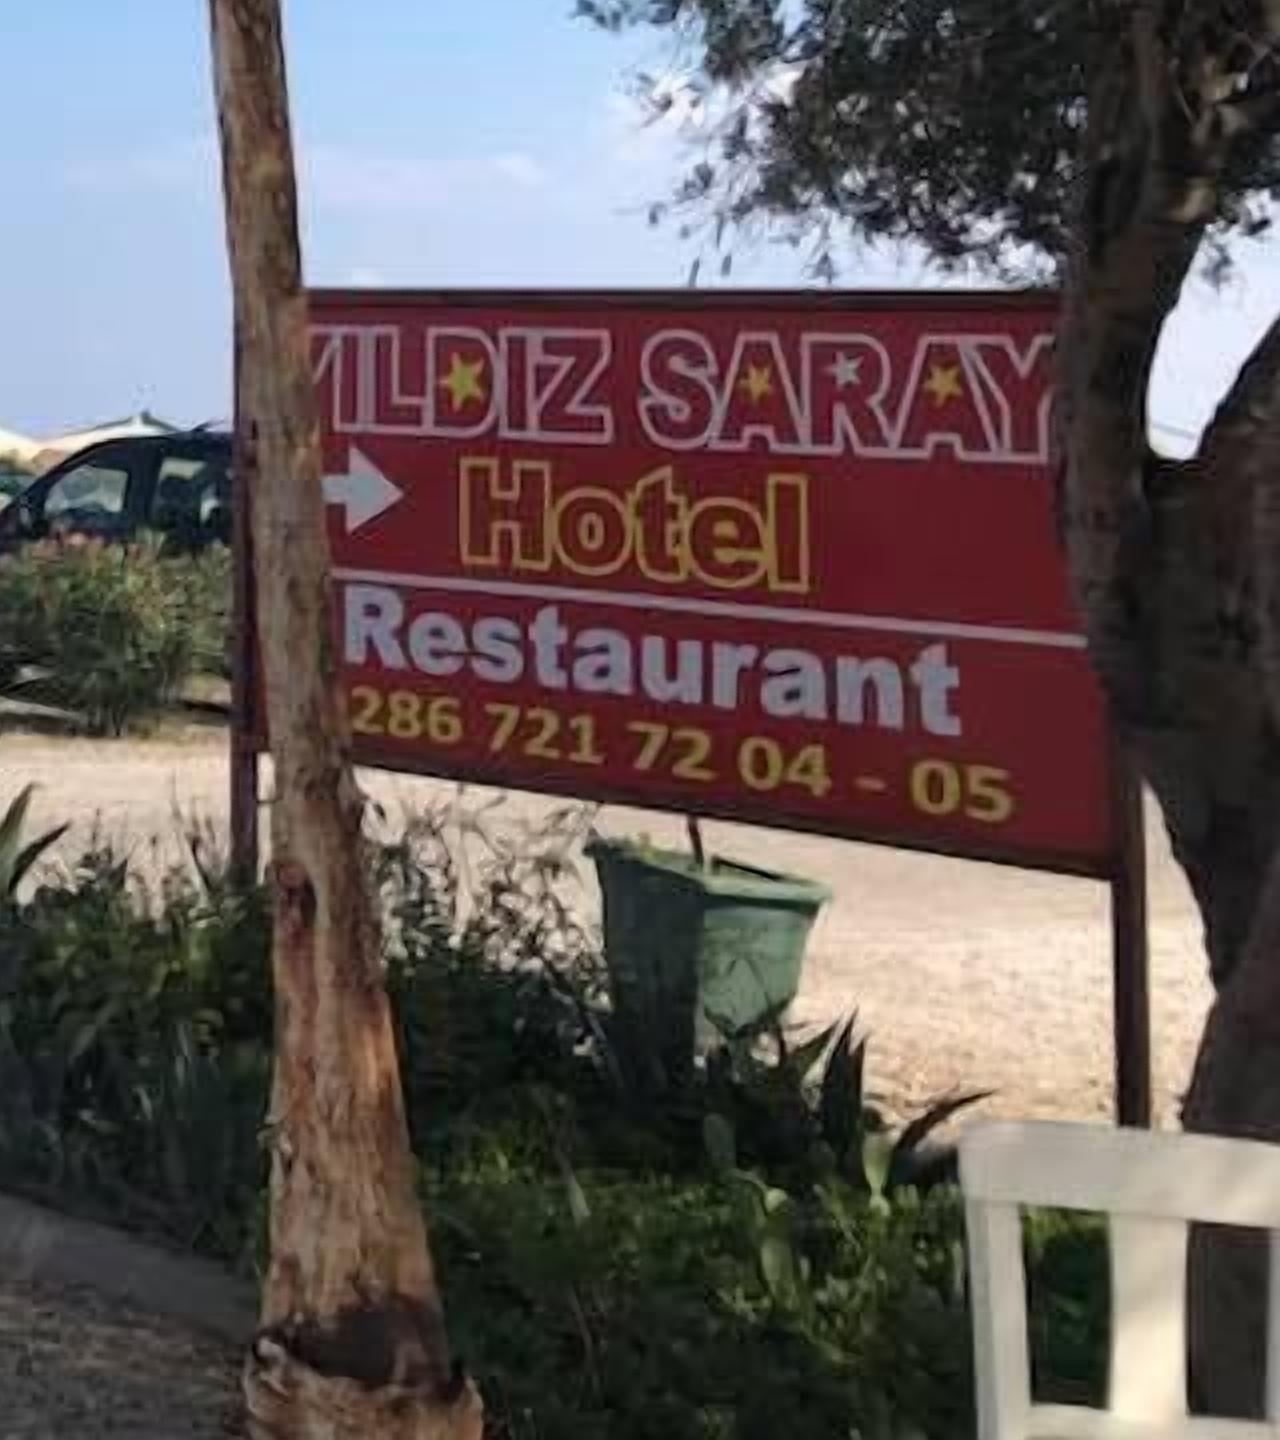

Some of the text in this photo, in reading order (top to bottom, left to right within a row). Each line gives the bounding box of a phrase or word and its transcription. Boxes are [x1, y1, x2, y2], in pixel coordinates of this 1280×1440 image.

[308, 324, 1057, 466] ILDIZ SARAY
[458, 455, 810, 594] Hotel
[343, 583, 962, 737] Restaurant
[350, 685, 465, 744] 286
[484, 702, 606, 766] 721
[627, 720, 717, 781] 72
[738, 736, 833, 798] 04
[910, 759, 1016, 825] 05
